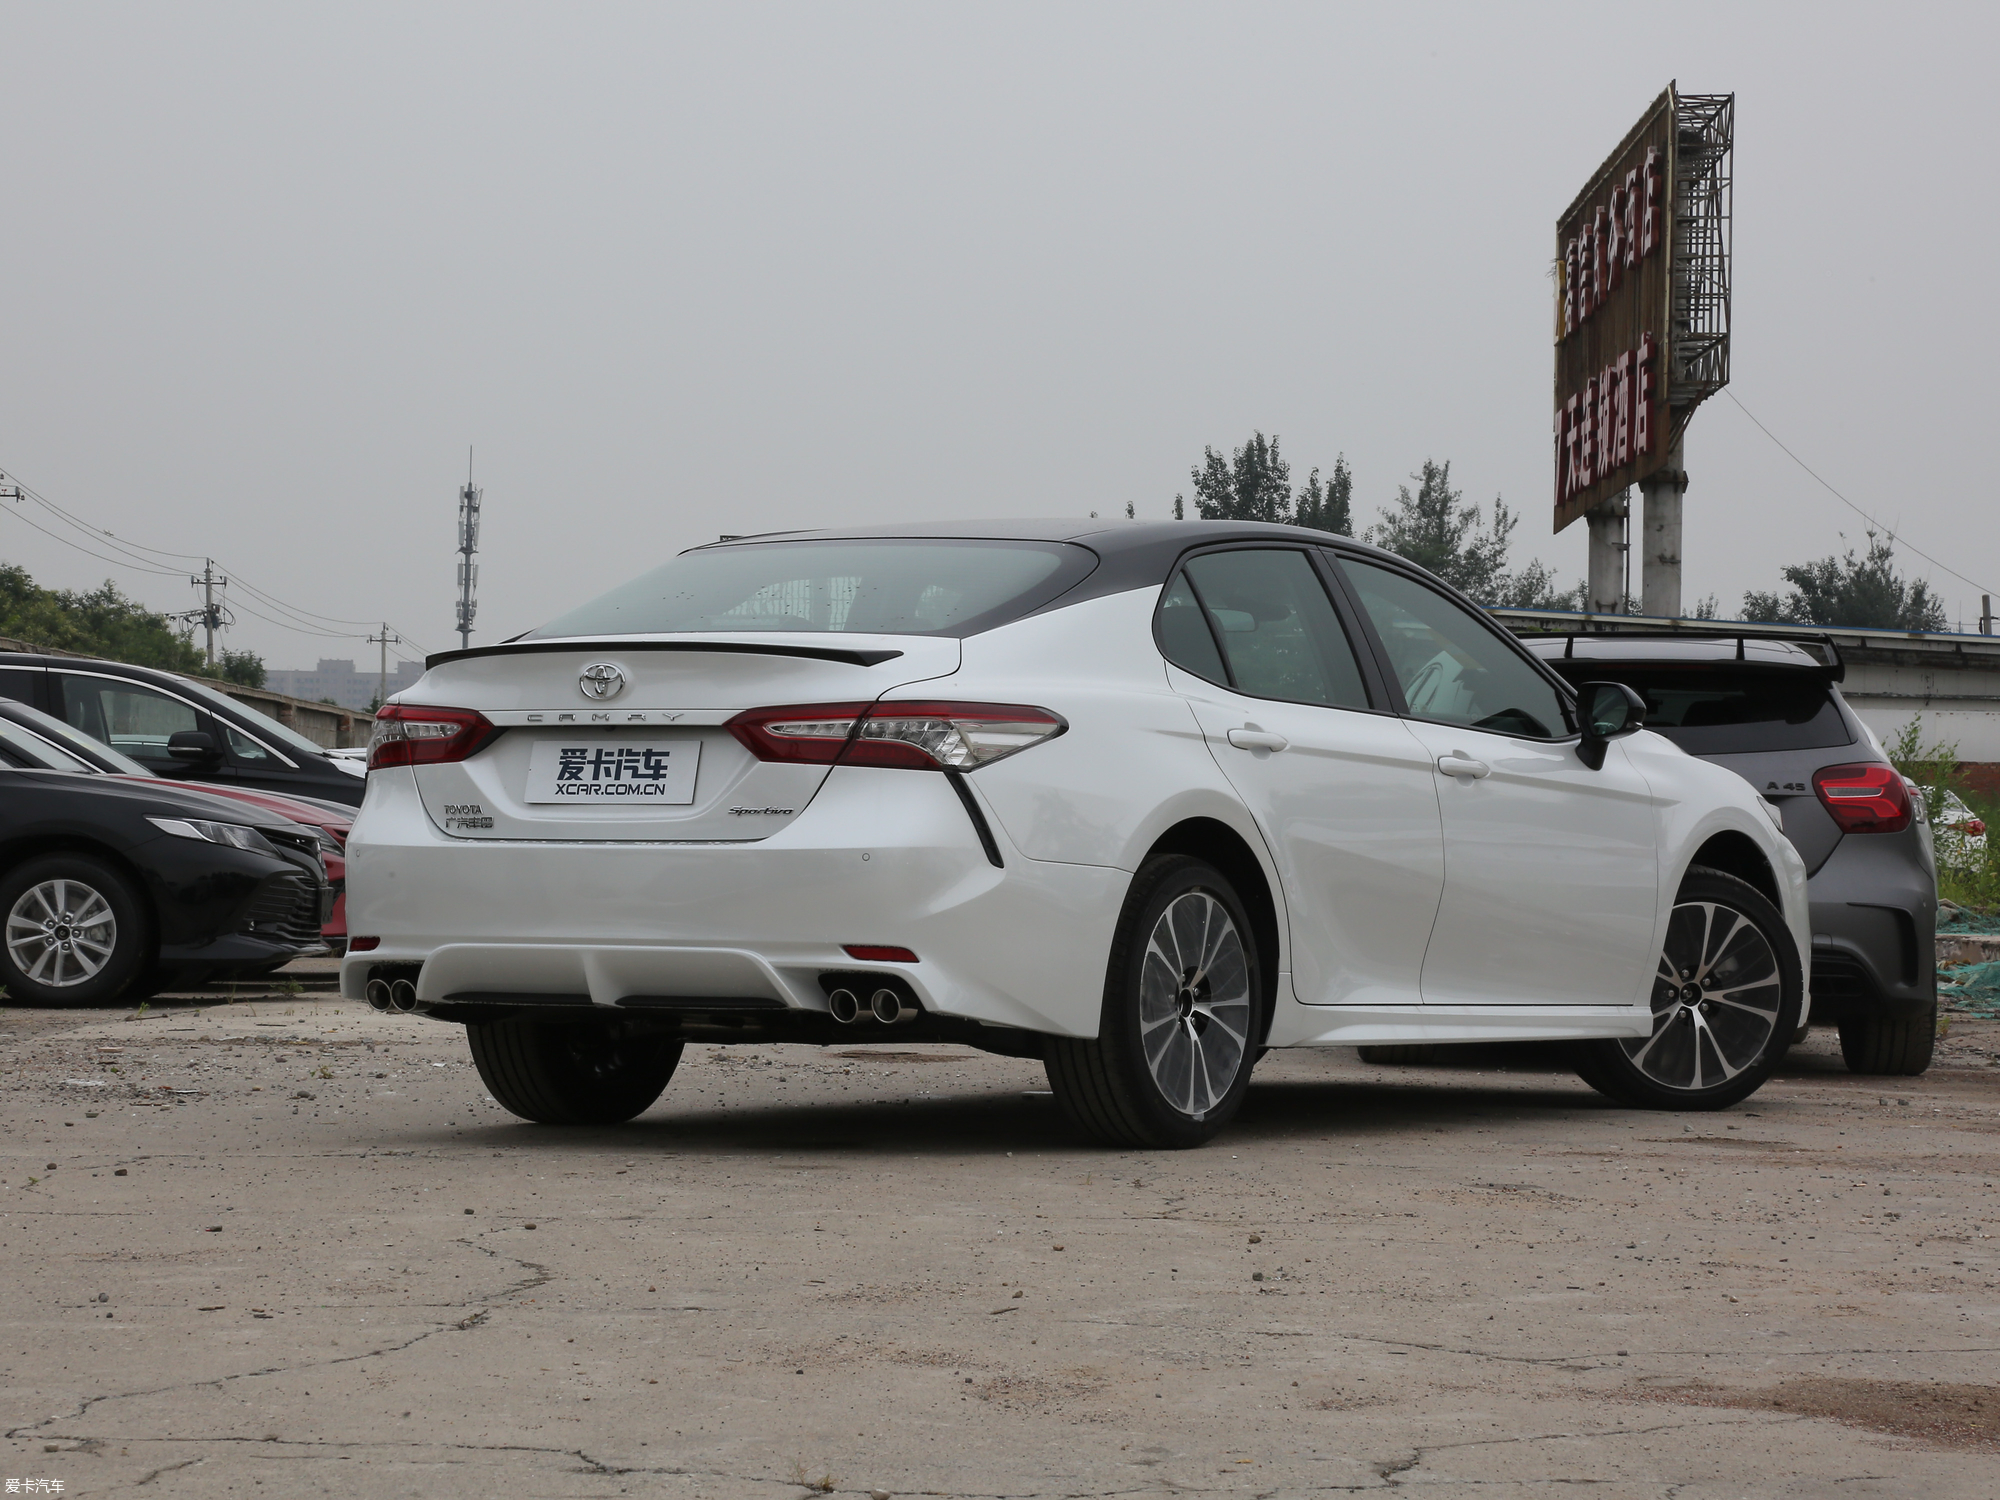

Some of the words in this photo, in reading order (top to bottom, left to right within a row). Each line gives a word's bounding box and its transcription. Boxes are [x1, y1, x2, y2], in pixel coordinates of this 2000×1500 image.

[1555, 331, 1657, 507] 7天连锁酒店
[527, 712, 685, 723] CAMRY
[556, 748, 671, 781] 爱卡汽车
[555, 783, 666, 796] XCAR.COM.CN
[1766, 781, 1780, 790] A
[1783, 782, 1806, 791] 45
[443, 804, 483, 814] TOYOTA
[728, 805, 794, 816] Sportivo
